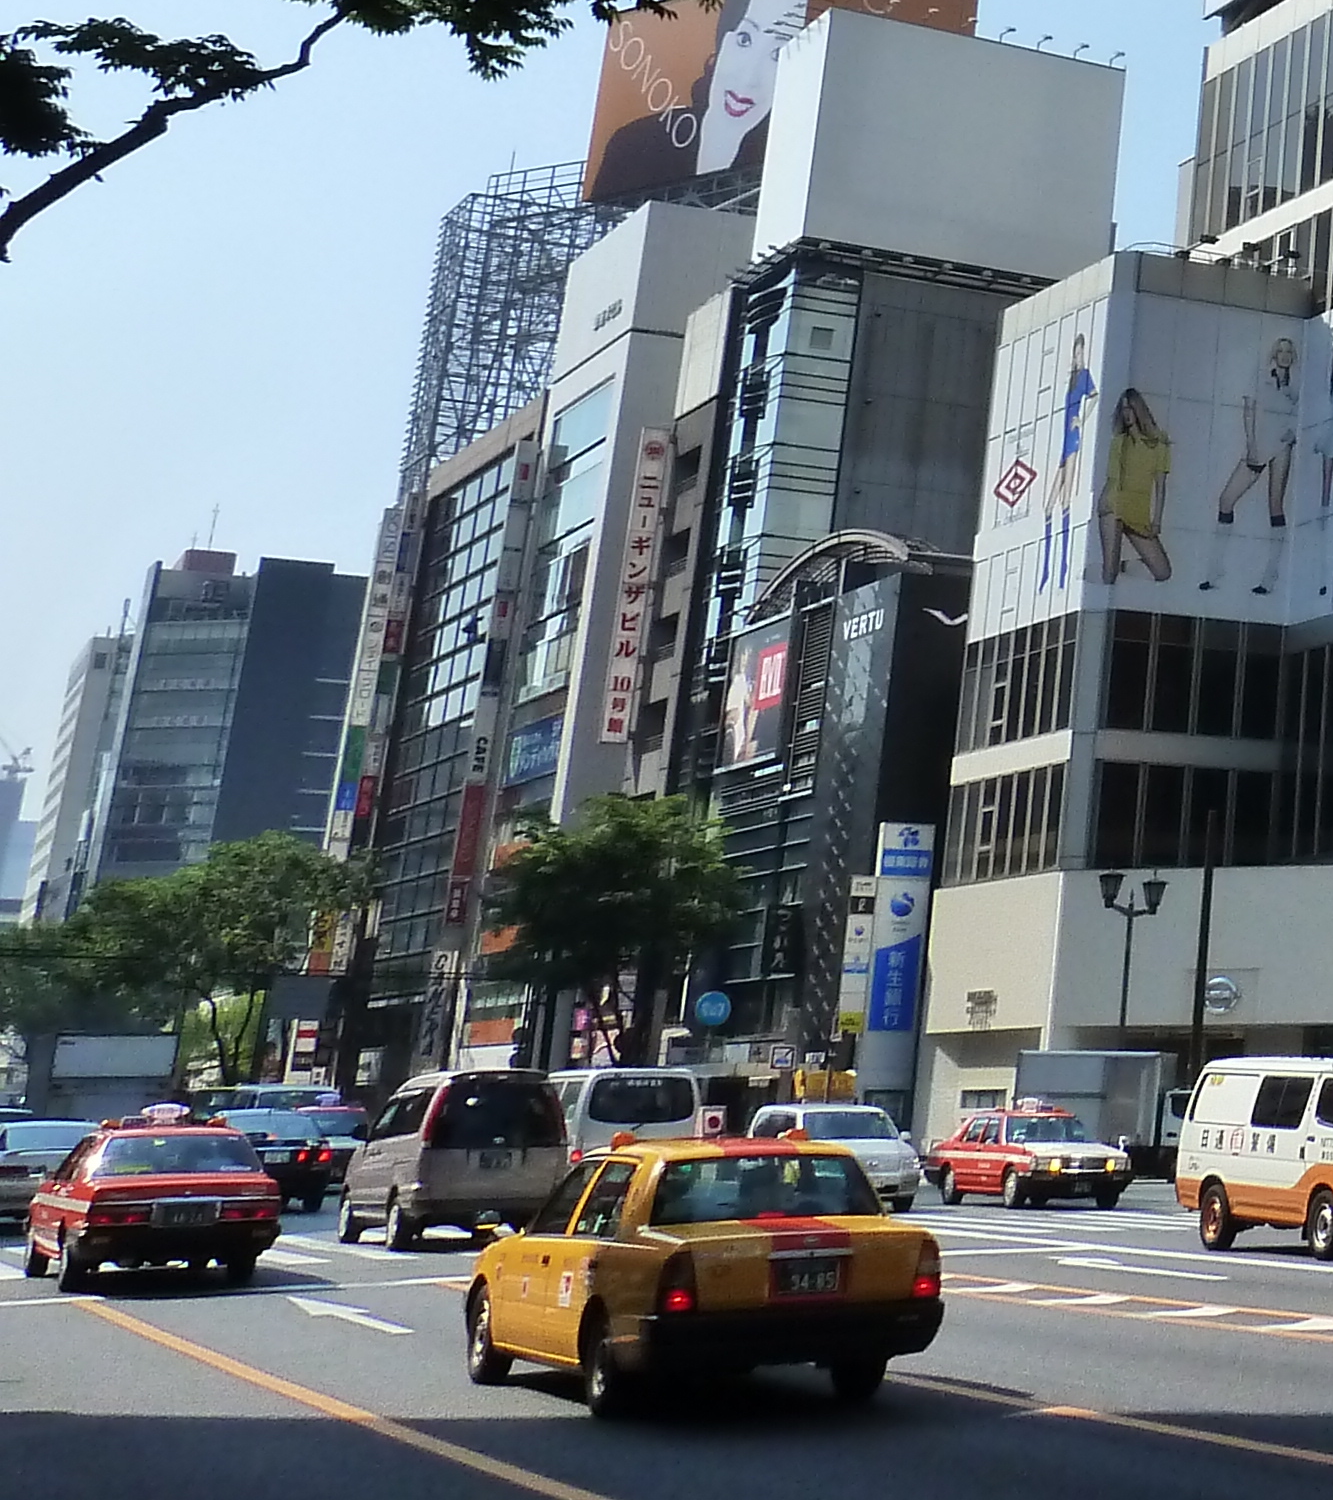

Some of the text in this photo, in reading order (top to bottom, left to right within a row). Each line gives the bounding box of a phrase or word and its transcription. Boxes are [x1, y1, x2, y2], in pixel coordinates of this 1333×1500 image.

[608, 19, 698, 149] SONOKO
[614, 474, 660, 660] ニューギンザビル
[841, 607, 886, 643] VERTU
